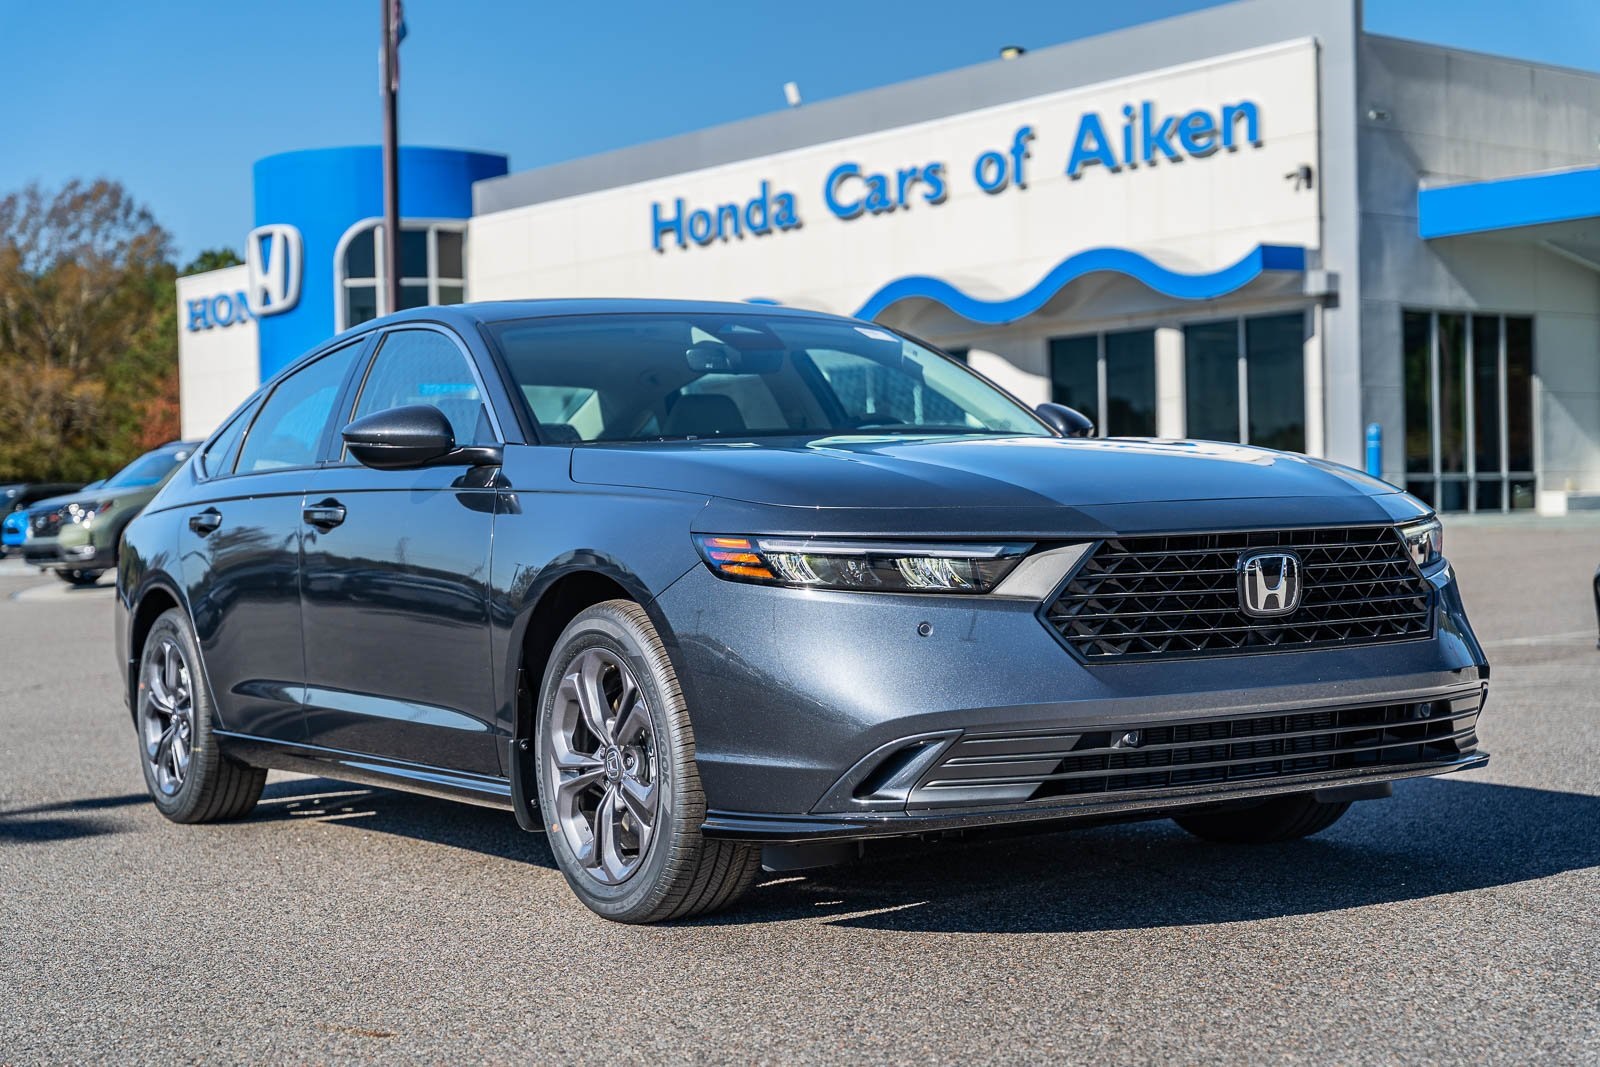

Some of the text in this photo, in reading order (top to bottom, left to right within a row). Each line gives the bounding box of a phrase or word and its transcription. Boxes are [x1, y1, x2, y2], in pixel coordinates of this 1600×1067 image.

[652, 100, 1260, 251] Honda Cars of Aiken
